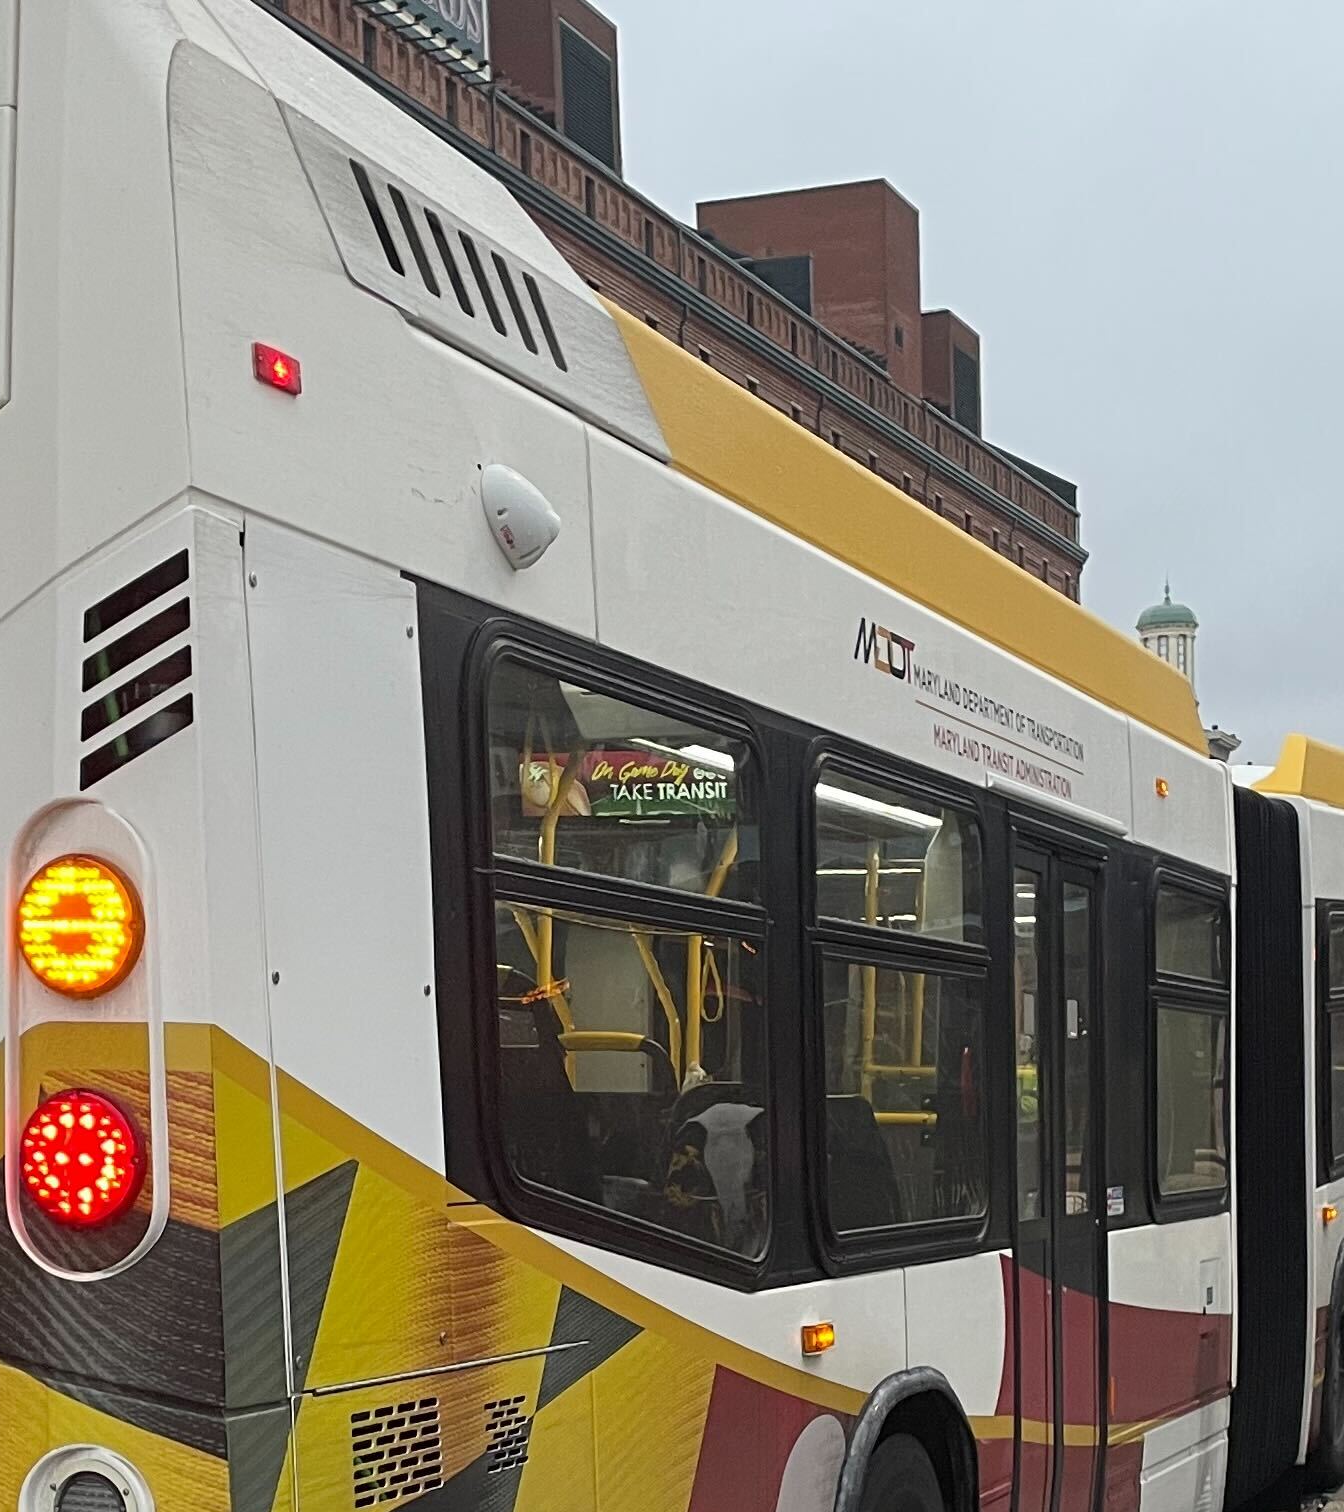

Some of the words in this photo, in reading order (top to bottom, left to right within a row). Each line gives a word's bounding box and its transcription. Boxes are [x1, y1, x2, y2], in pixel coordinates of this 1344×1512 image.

[913, 663, 960, 706] MARYLAND
[962, 687, 1014, 730] DEPARTMENT
[1026, 716, 1085, 763] TRANSPORTATION
[591, 760, 614, 781] On
[618, 760, 659, 784] Game
[933, 723, 980, 762] MARYLAND
[981, 743, 1014, 777] TRANSIT
[1016, 758, 1073, 800] ADMINISTRATION
[609, 783, 654, 801] TAKE
[656, 781, 728, 801] TRANSIT
